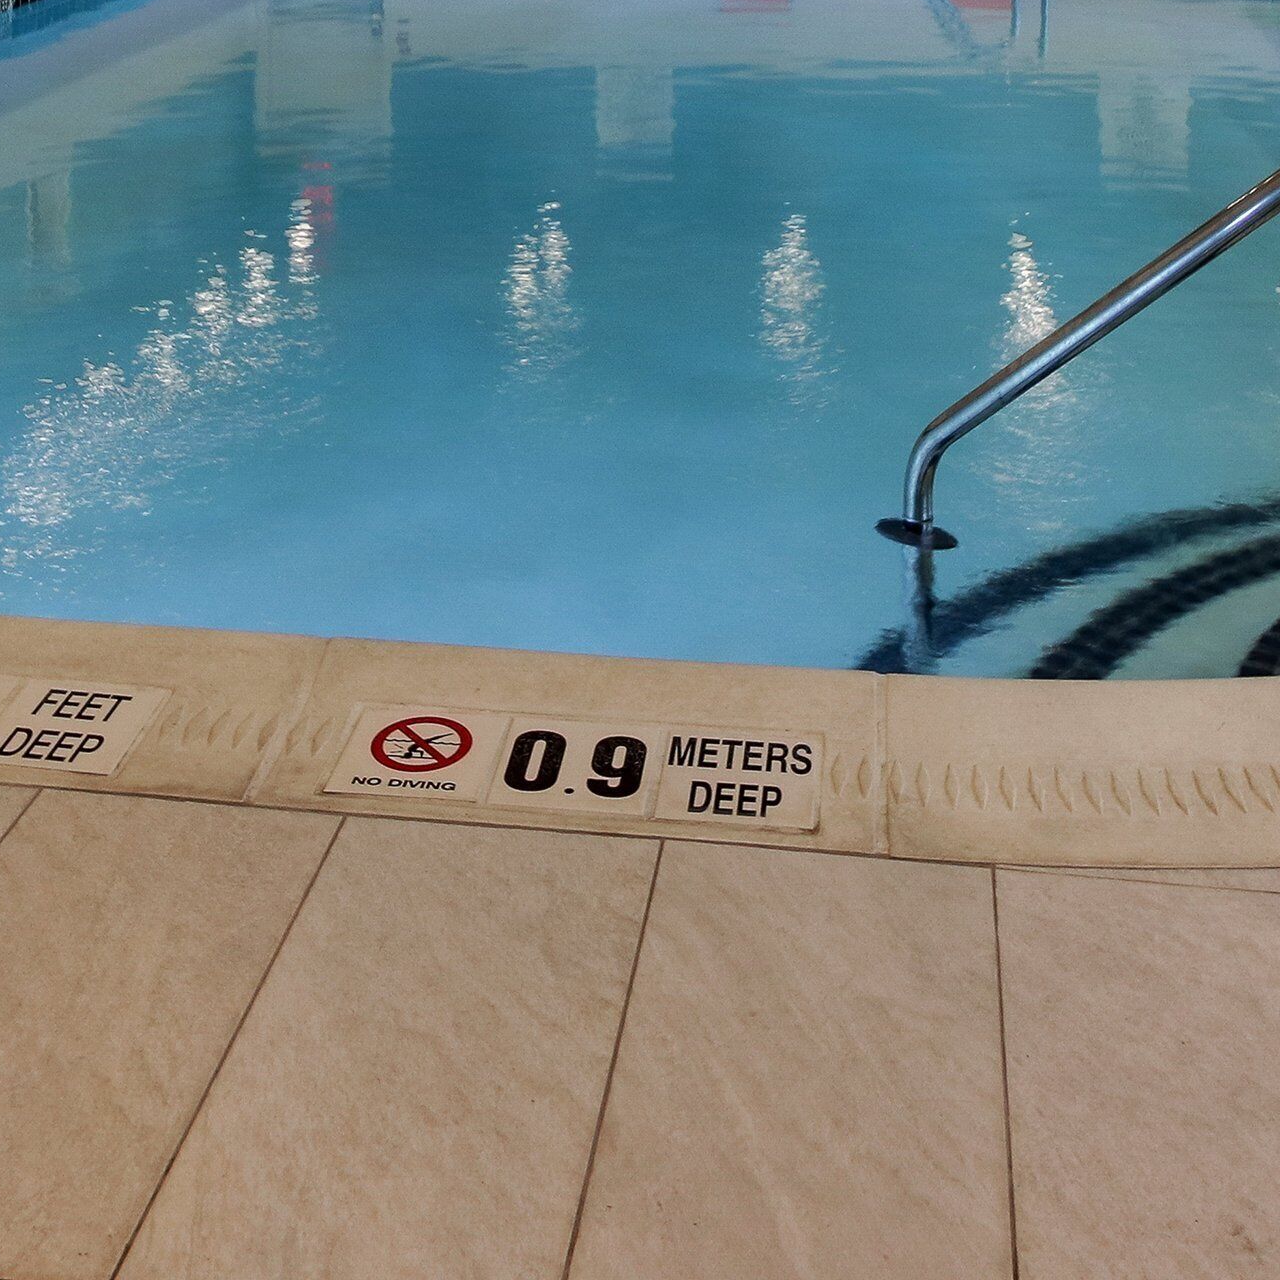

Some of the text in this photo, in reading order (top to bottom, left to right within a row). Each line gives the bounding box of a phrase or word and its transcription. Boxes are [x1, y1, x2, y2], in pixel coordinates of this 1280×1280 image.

[31, 688, 133, 722] FEET
[503, 729, 648, 800] 0.9
[668, 736, 813, 776] METERS
[351, 776, 457, 792] NO DIVING
[687, 780, 783, 819] DEEP
